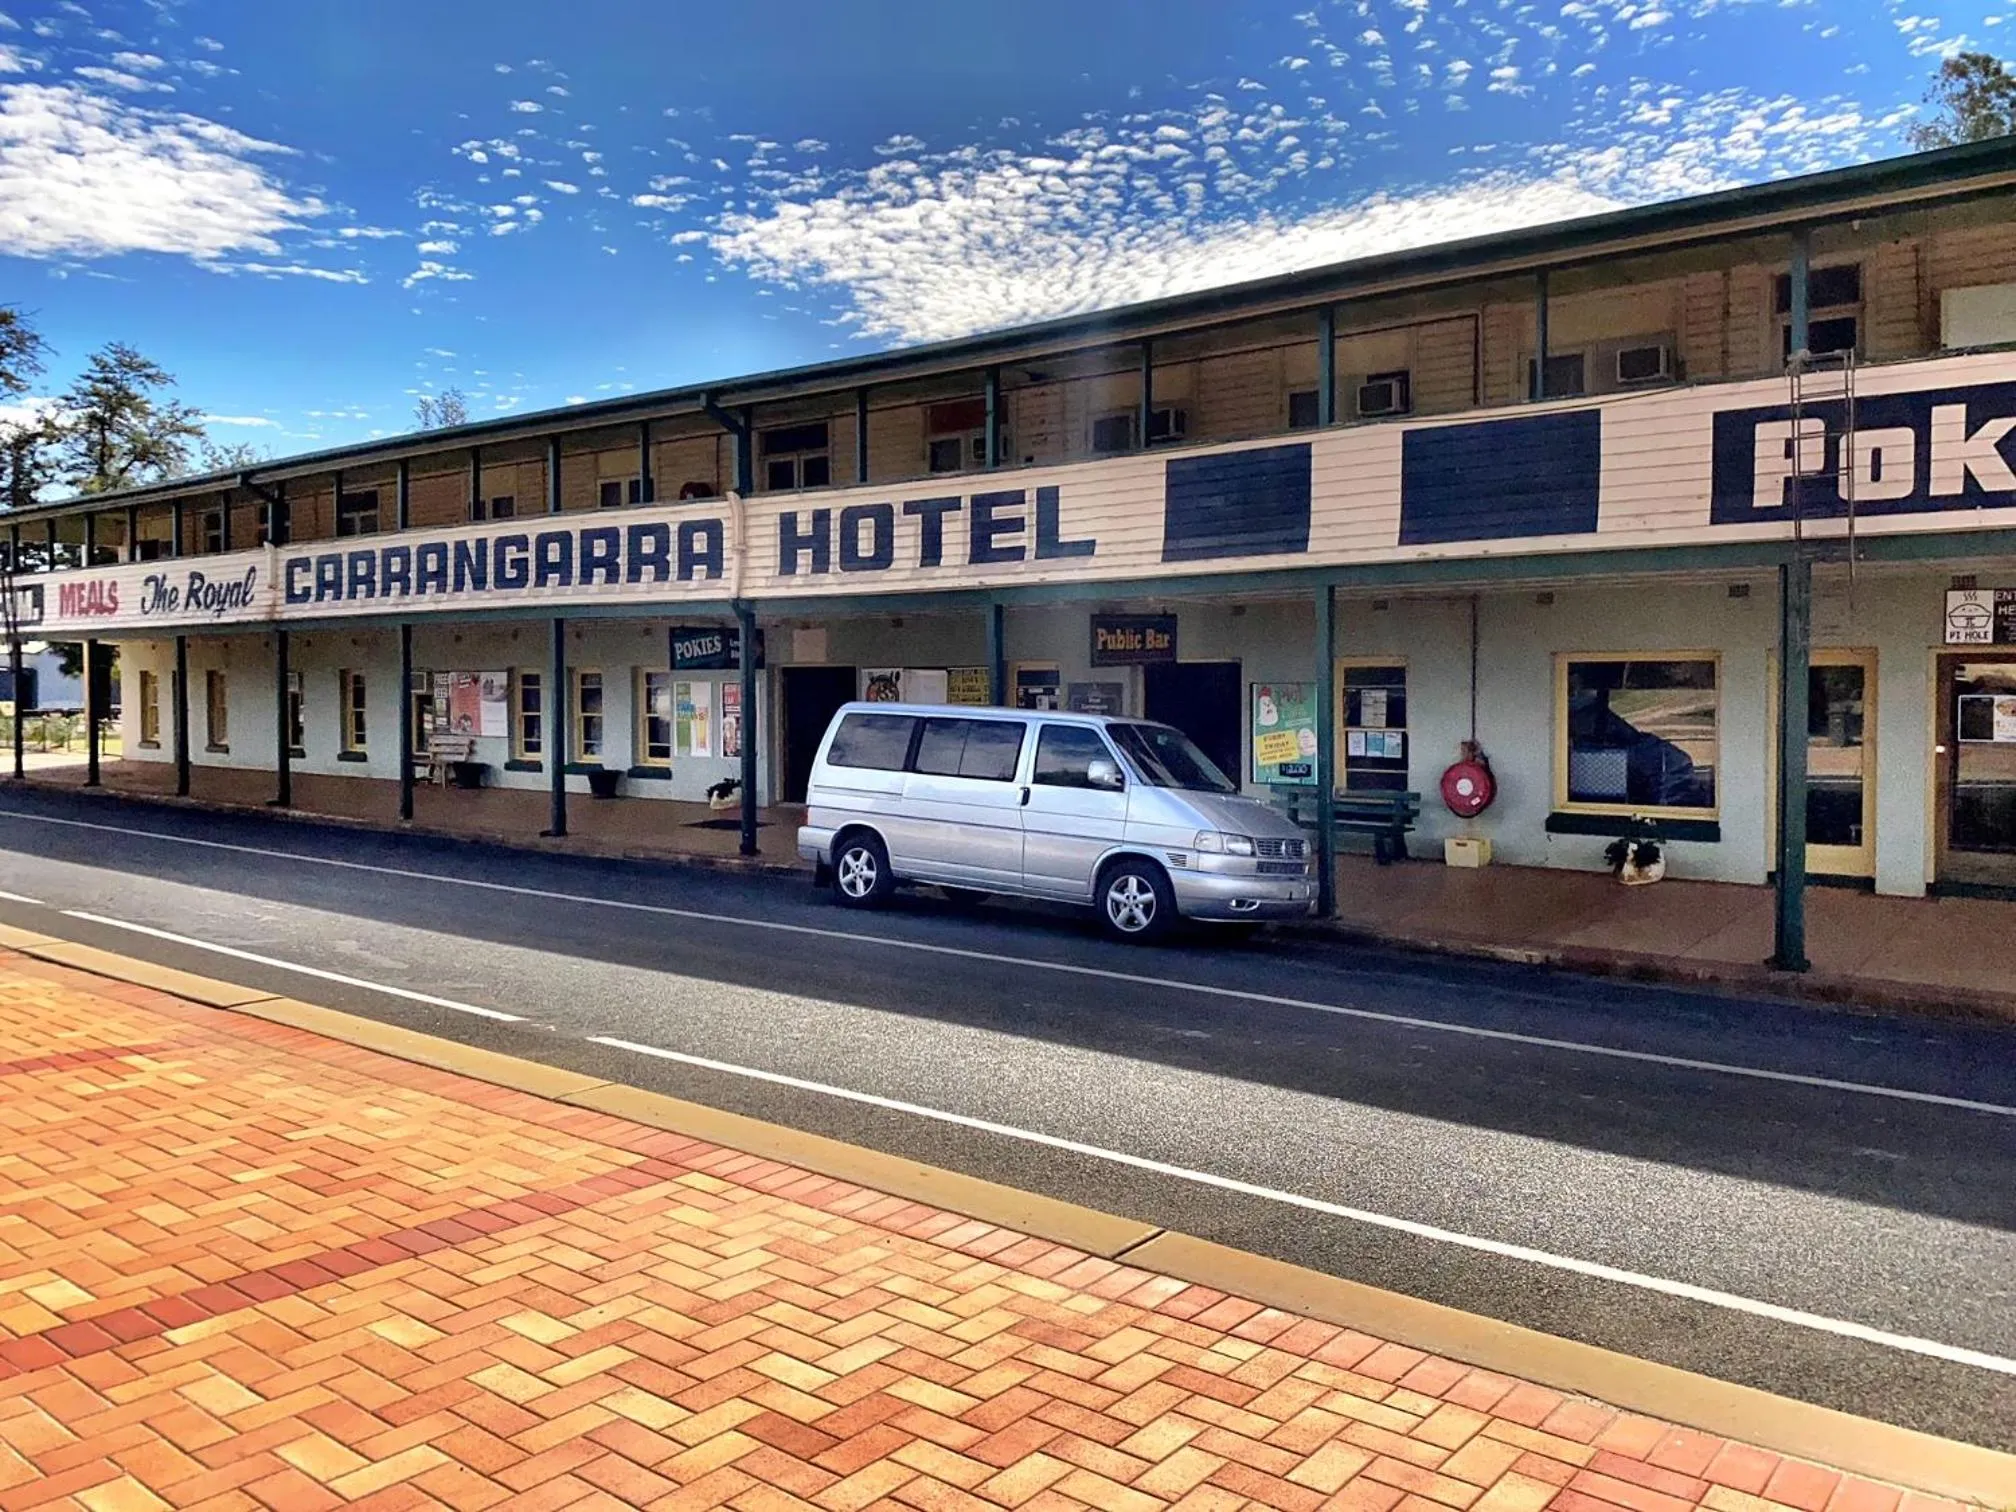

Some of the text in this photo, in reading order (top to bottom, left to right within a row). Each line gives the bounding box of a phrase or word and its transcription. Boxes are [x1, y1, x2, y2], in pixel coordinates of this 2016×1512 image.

[778, 486, 1096, 576] HOTEL
[285, 518, 724, 604] CARRANGARRA
[59, 580, 119, 617] MEALS
[141, 565, 257, 618] The Royal
[674, 635, 722, 660] POKIES
[1096, 628, 1170, 650] Public Bar
[1964, 630, 1990, 641] HOLE
